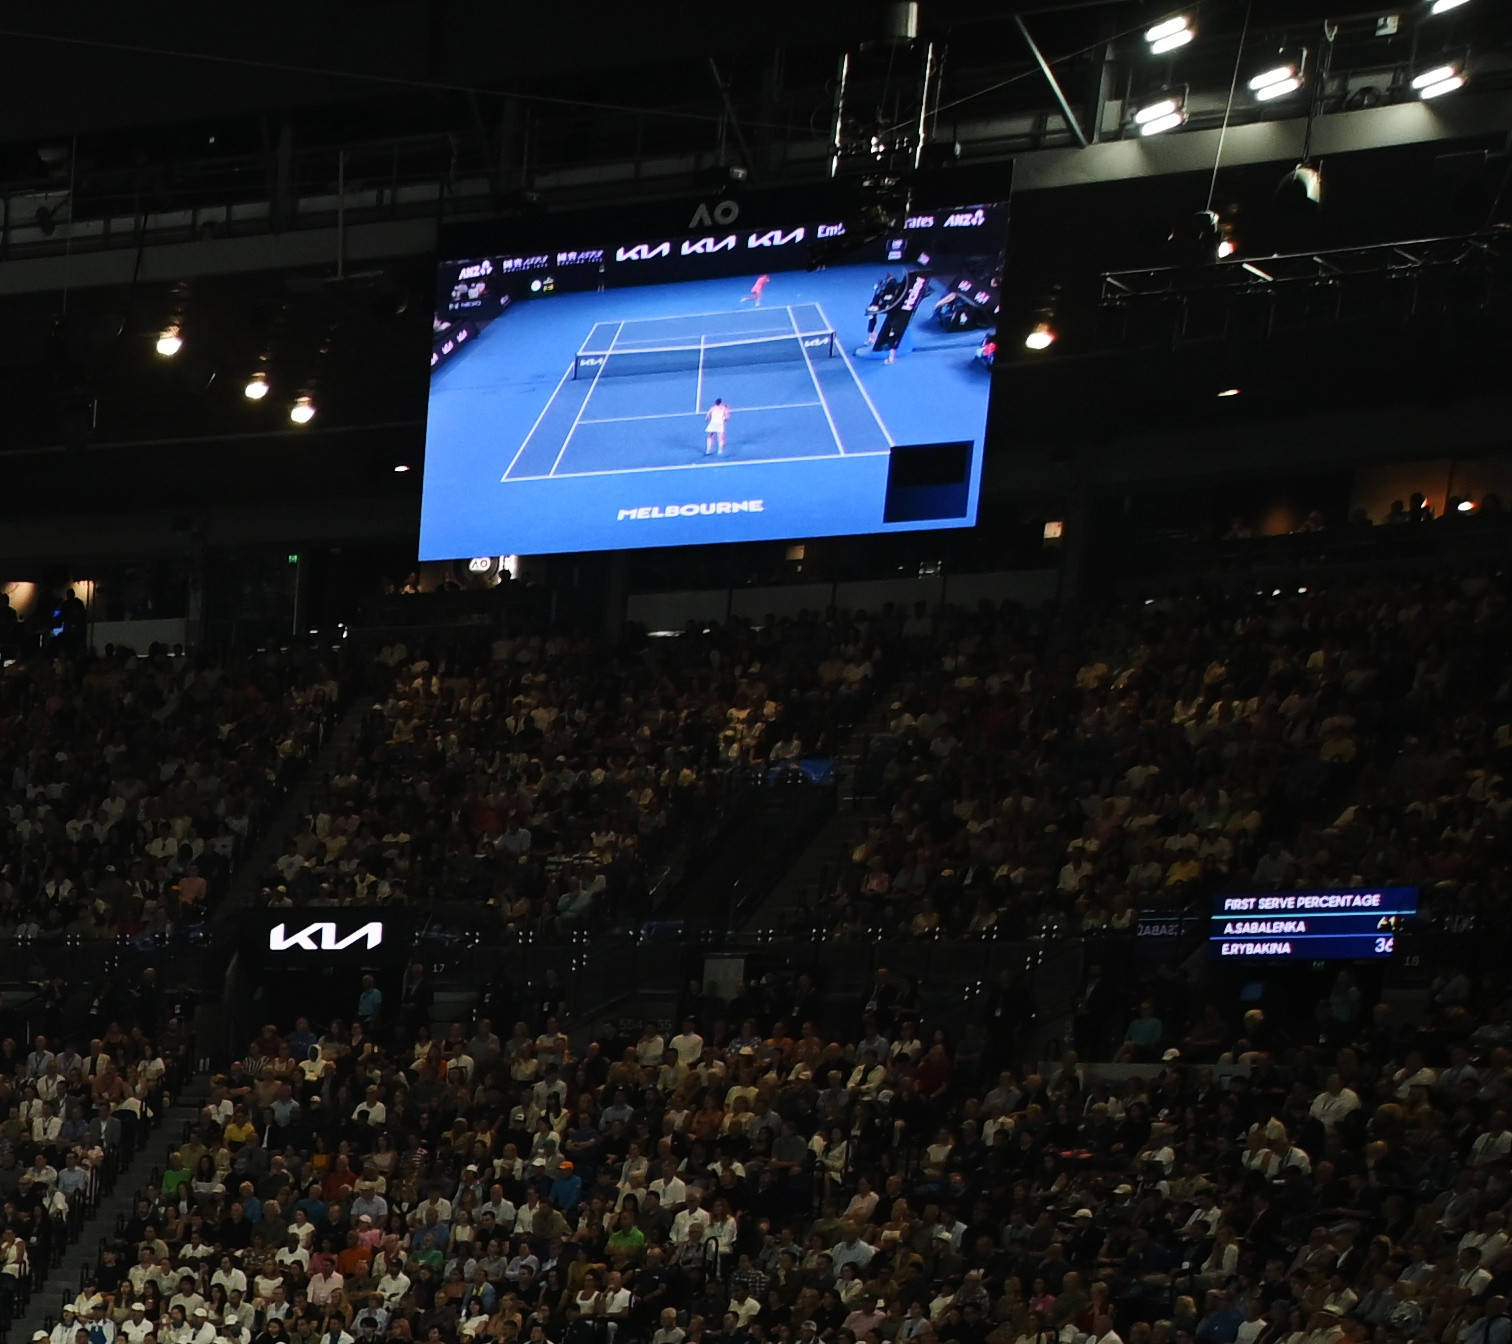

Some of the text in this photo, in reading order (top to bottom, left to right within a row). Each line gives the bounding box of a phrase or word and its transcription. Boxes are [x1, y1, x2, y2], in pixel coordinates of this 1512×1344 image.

[689, 200, 740, 228] AO
[681, 234, 737, 255] KIA
[748, 227, 805, 248] KIA
[616, 241, 670, 262] KIA
[617, 500, 764, 520] MELBOURNE
[1224, 894, 1381, 910] FIRST SERVE PERCENTAGE
[270, 922, 383, 951] KIA
